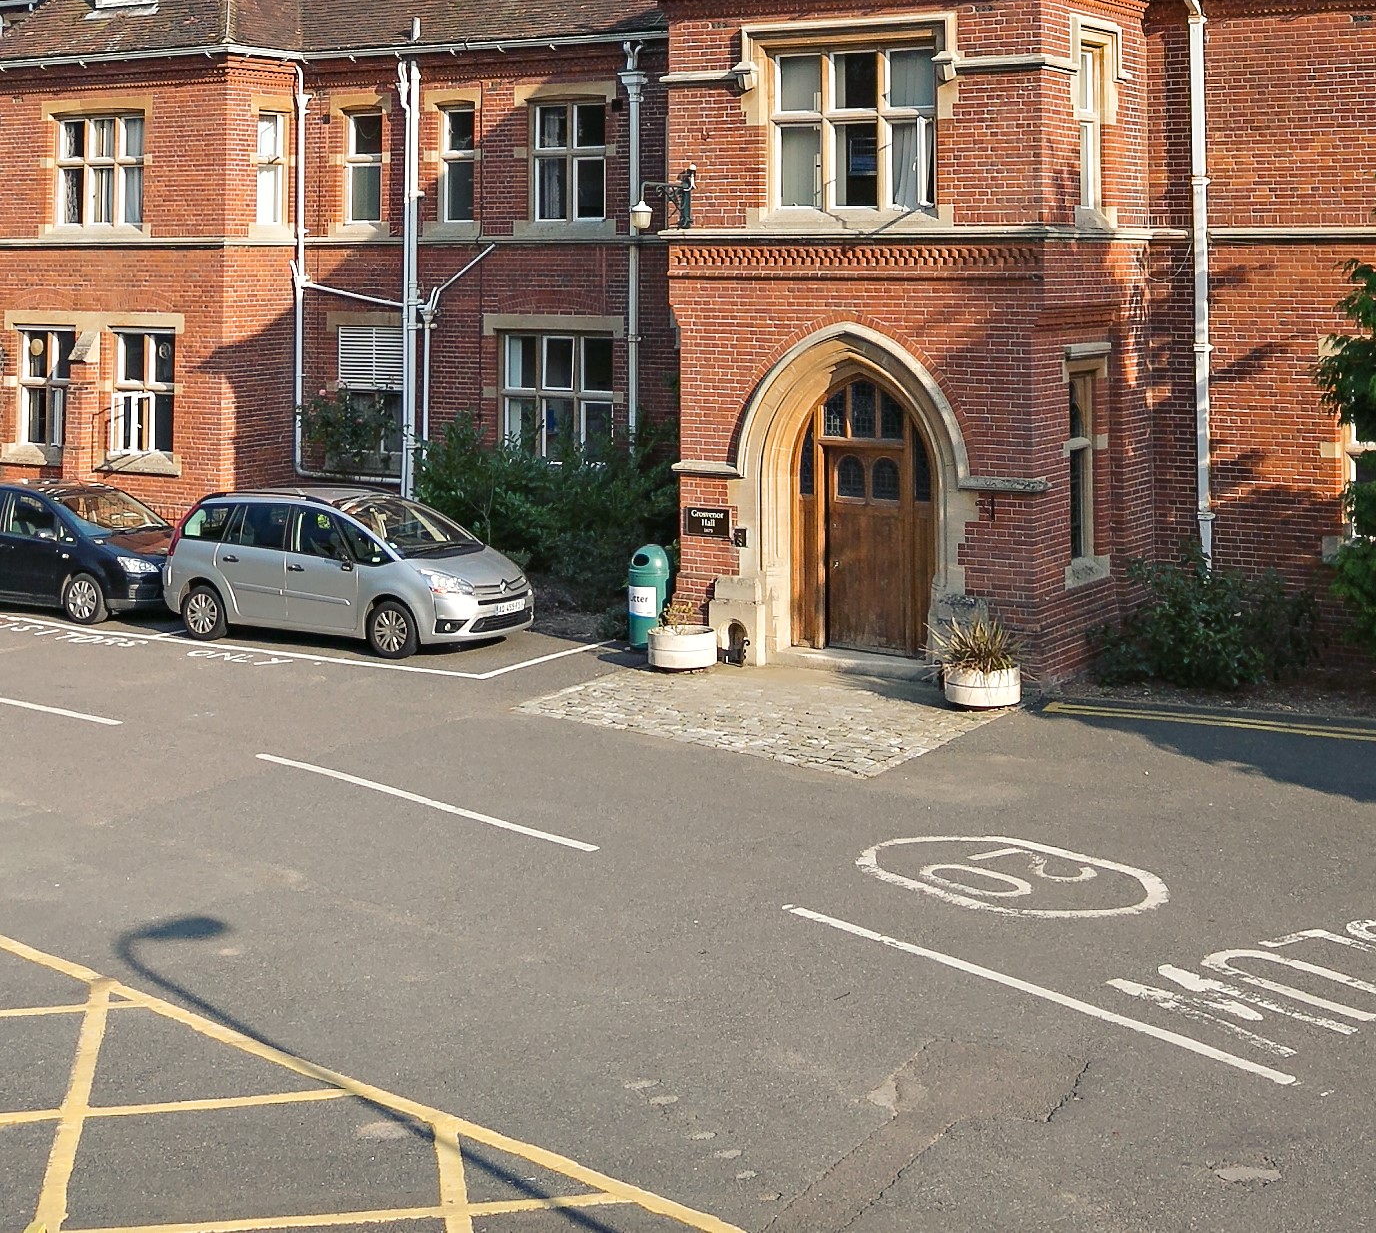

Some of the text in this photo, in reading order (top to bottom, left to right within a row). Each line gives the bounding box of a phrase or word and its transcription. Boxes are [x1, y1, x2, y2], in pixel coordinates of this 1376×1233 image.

[691, 509, 724, 519] Grosvenor
[701, 518, 716, 527] Hall
[0, 621, 293, 666] ISITORS ONLY
[919, 848, 1098, 898] 20
